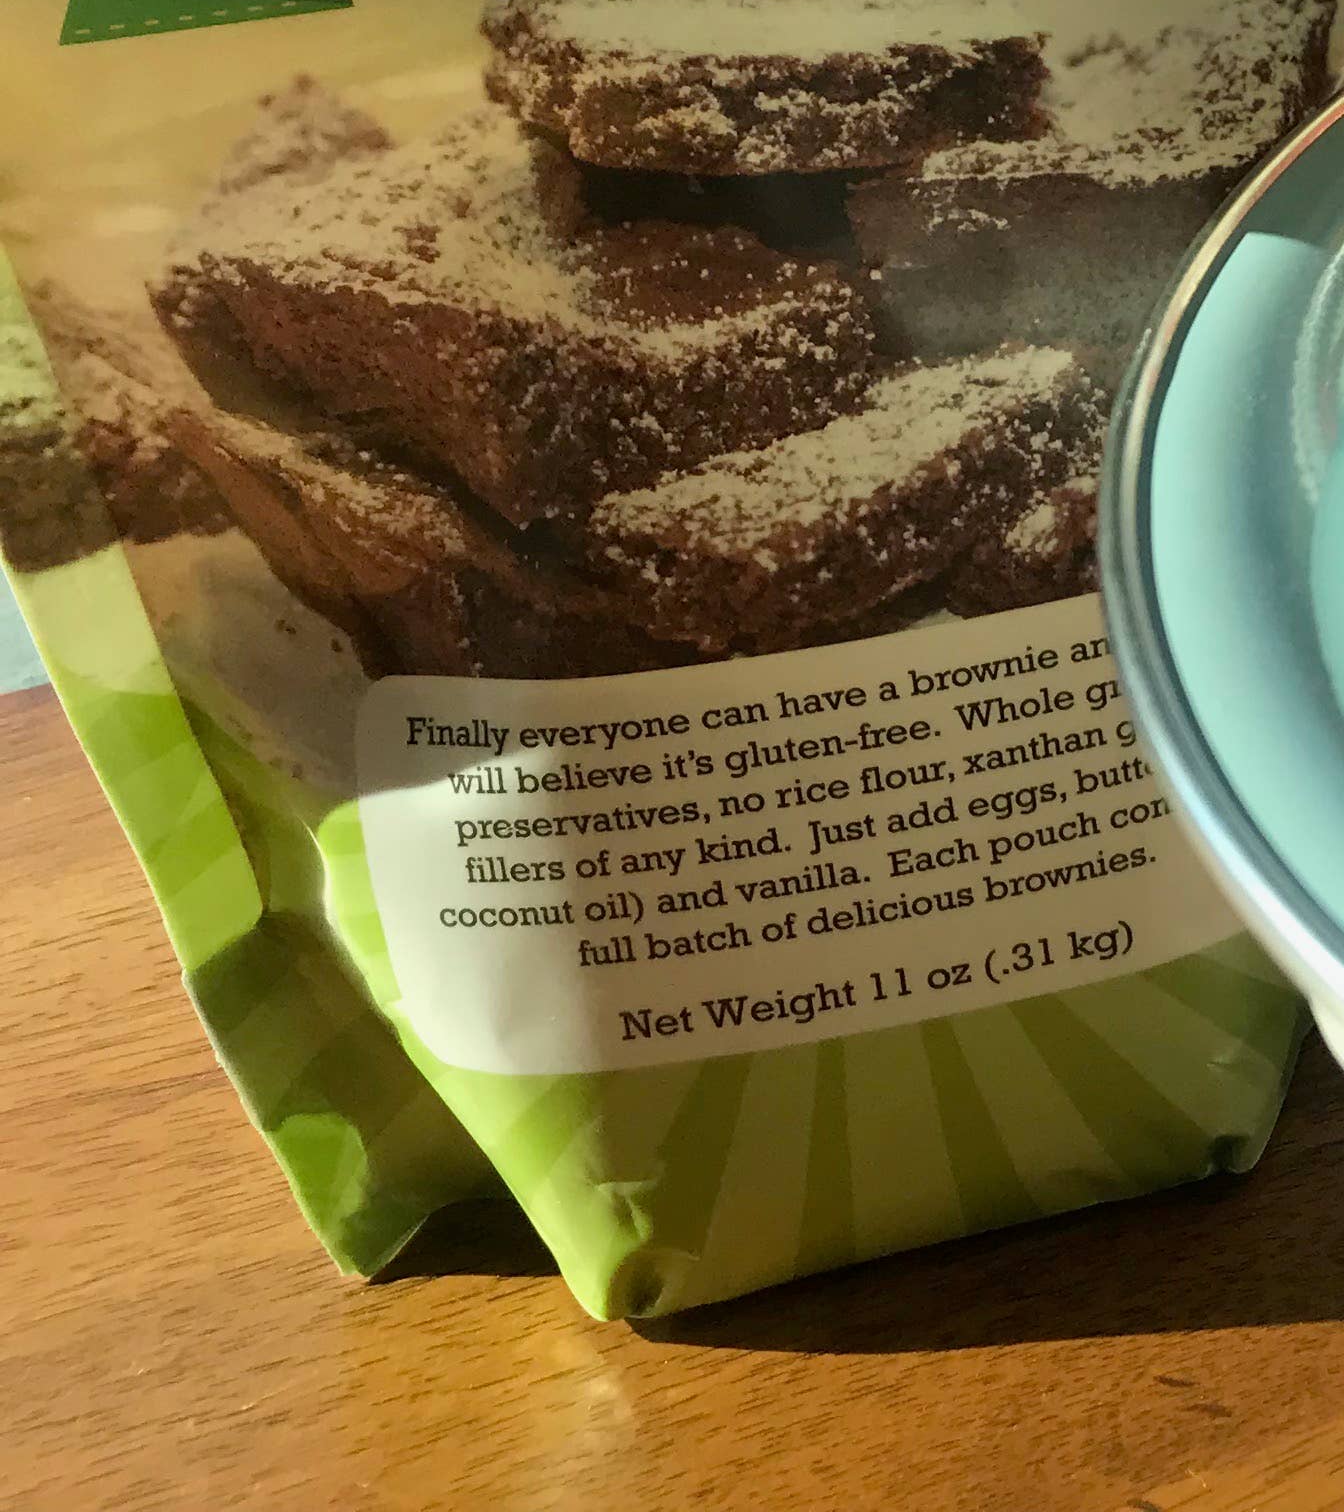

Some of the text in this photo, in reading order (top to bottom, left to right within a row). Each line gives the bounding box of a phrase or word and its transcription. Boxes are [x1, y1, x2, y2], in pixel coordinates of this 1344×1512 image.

[406, 717, 510, 755] Finally
[519, 712, 690, 750] everyone
[701, 701, 770, 730] can
[777, 686, 867, 722] have
[879, 680, 900, 701] a
[908, 646, 1059, 696] brownie
[447, 766, 508, 795] will
[515, 763, 653, 794] believe
[663, 750, 714, 780] it’s
[725, 723, 941, 778] gluten-free.
[953, 688, 1075, 731] Whole
[455, 801, 711, 846] preservatives,
[718, 792, 765, 817] no
[775, 778, 850, 809] rice
[860, 759, 956, 794] flour,
[962, 726, 1107, 777] xanthan
[465, 856, 565, 884] fillers
[575, 850, 610, 879] of
[621, 847, 686, 876] any
[697, 827, 791, 865] kind.
[809, 813, 876, 855] Just
[887, 797, 960, 830] add
[968, 779, 1067, 820] eggs,
[439, 900, 575, 928] coconut
[585, 891, 644, 924] oil)
[657, 881, 728, 914] and
[735, 863, 870, 903] vanilla.
[888, 839, 980, 877] Each
[988, 813, 1101, 864] pouch
[578, 845, 1156, 967] full batch of delicious brownies.
[619, 920, 1134, 1041] Net Weight 11 oz (.31 kg)
